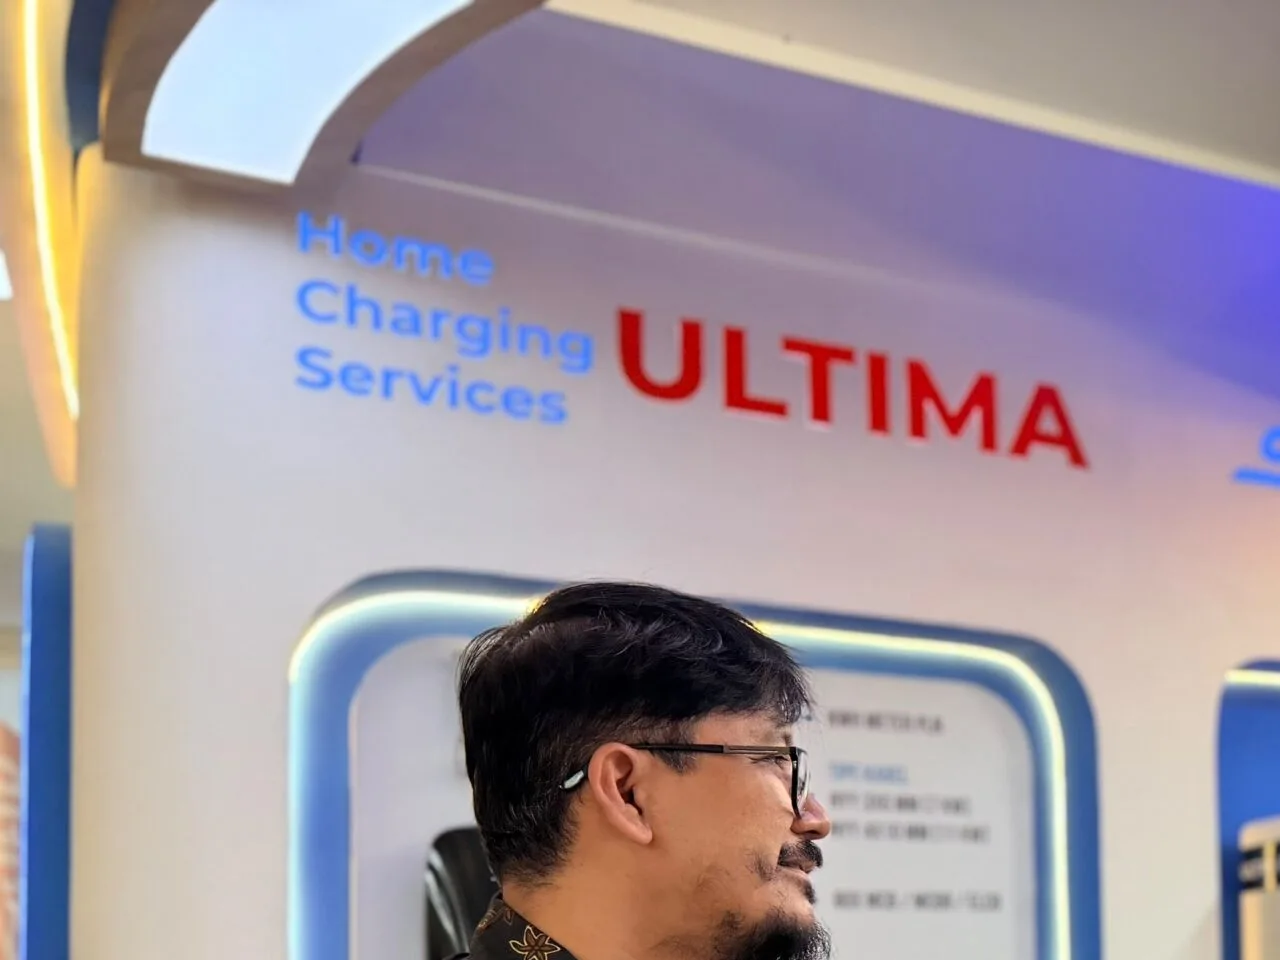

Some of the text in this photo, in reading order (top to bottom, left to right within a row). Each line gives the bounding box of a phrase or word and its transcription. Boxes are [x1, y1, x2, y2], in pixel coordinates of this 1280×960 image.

[296, 211, 496, 285] Home
[296, 279, 595, 374] Charging
[294, 347, 568, 425] Services
[617, 307, 1090, 470] ULTIMA
